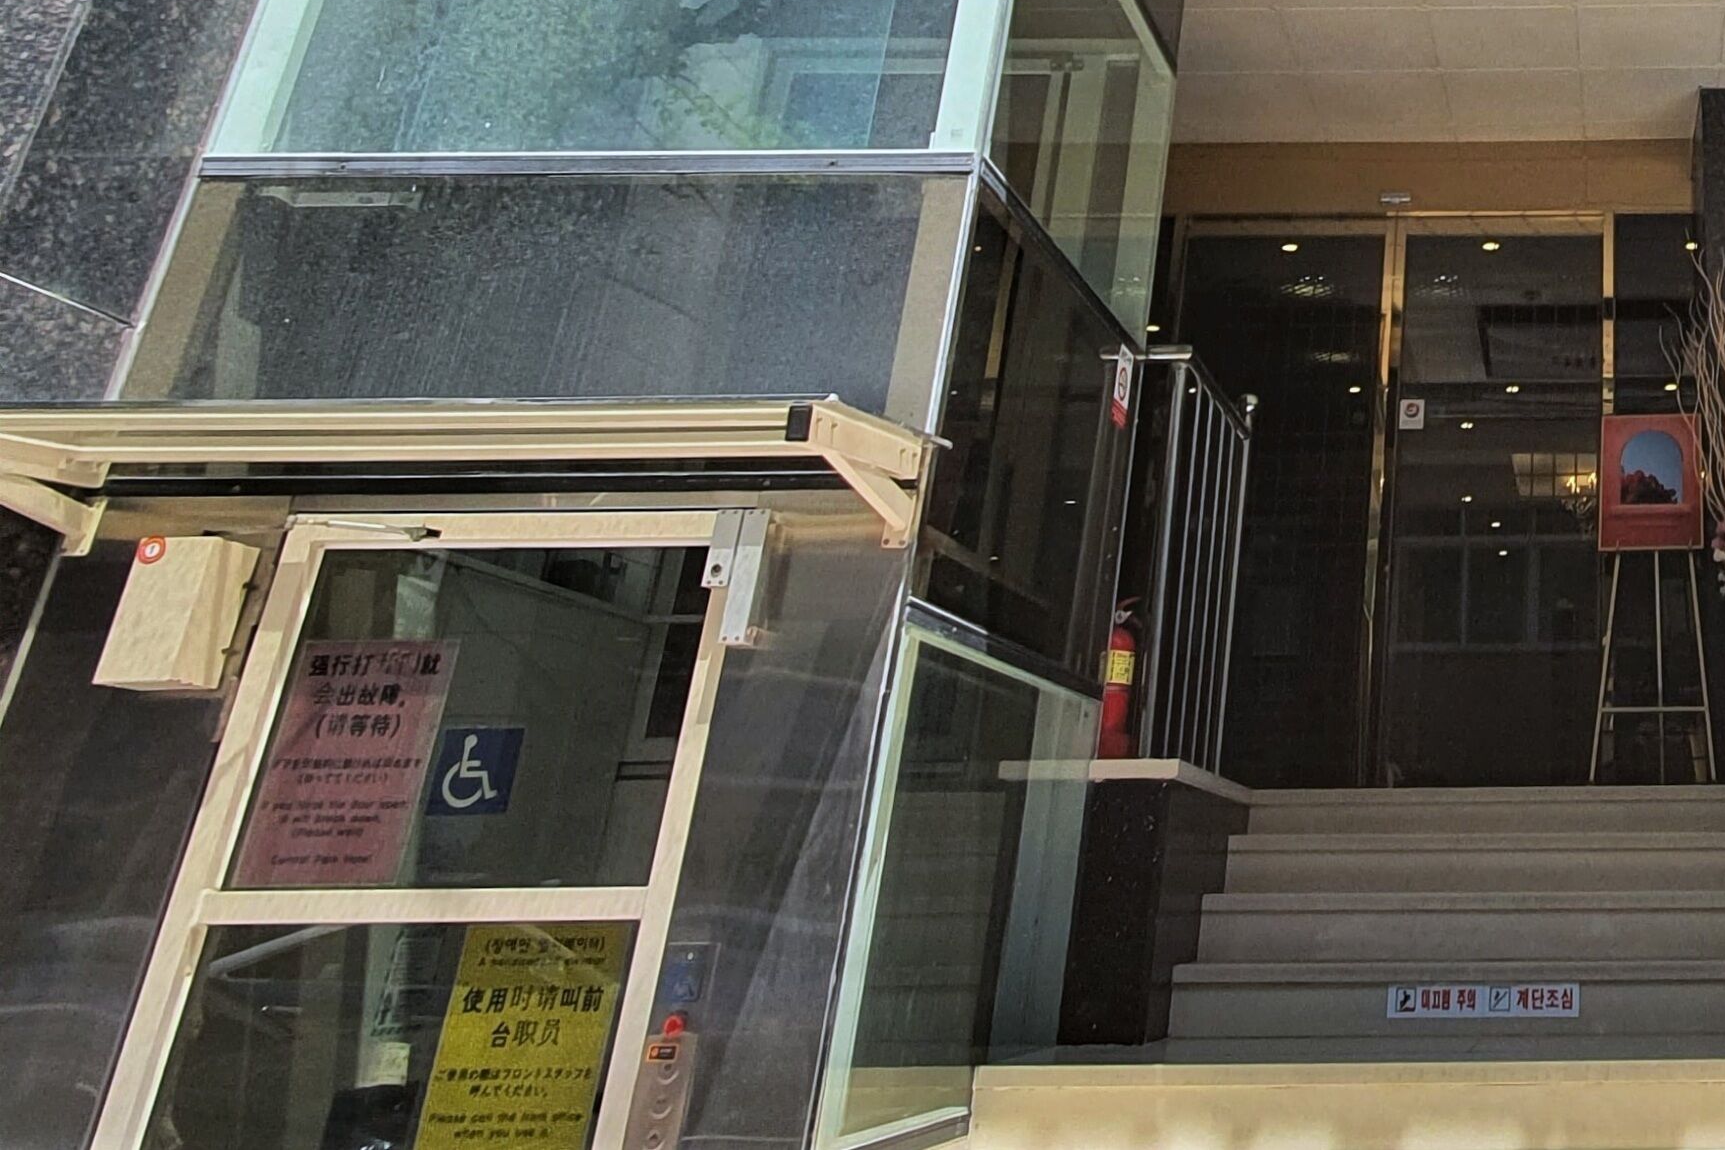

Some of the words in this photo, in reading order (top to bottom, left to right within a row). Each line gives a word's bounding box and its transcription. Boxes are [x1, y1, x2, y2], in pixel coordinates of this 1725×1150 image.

[462, 986, 604, 1013] 使用时请叫前
[1516, 988, 1574, 1010] 계단조심
[491, 1019, 561, 1049] 台职员
